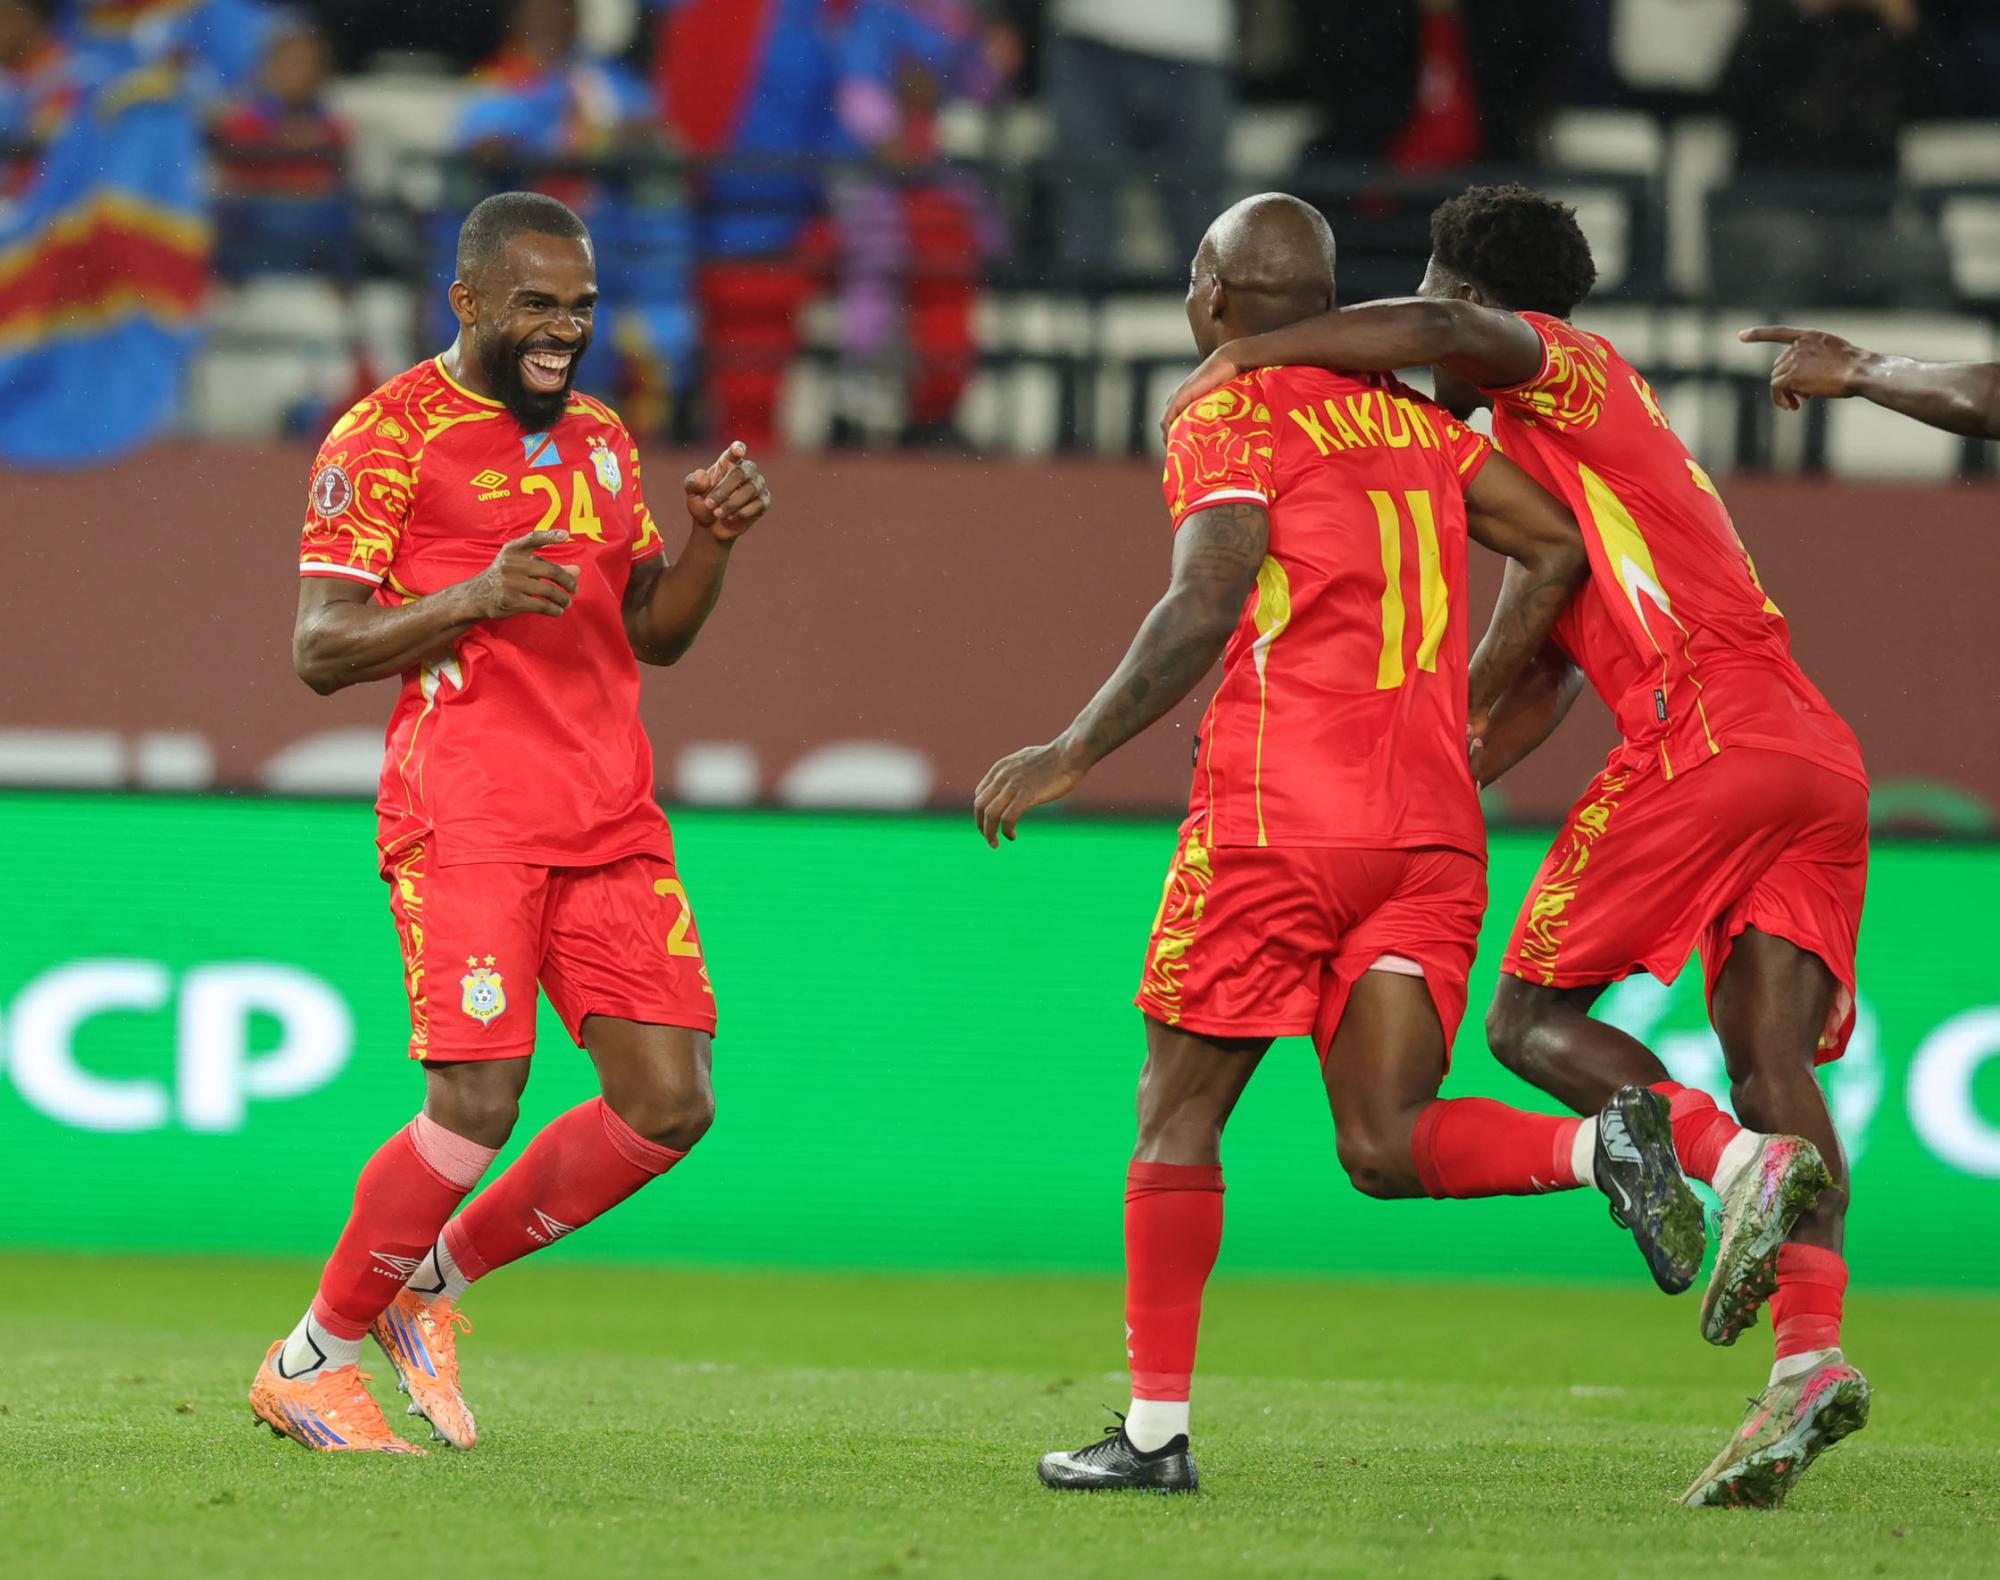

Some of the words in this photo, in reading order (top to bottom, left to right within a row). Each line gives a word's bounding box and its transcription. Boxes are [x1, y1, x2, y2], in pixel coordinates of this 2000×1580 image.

[478, 487, 510, 502] umbro
[520, 470, 608, 543] 24
[1366, 490, 1448, 690] 11
[0, 956, 357, 1134] CP
[372, 1266, 408, 1281] umb
